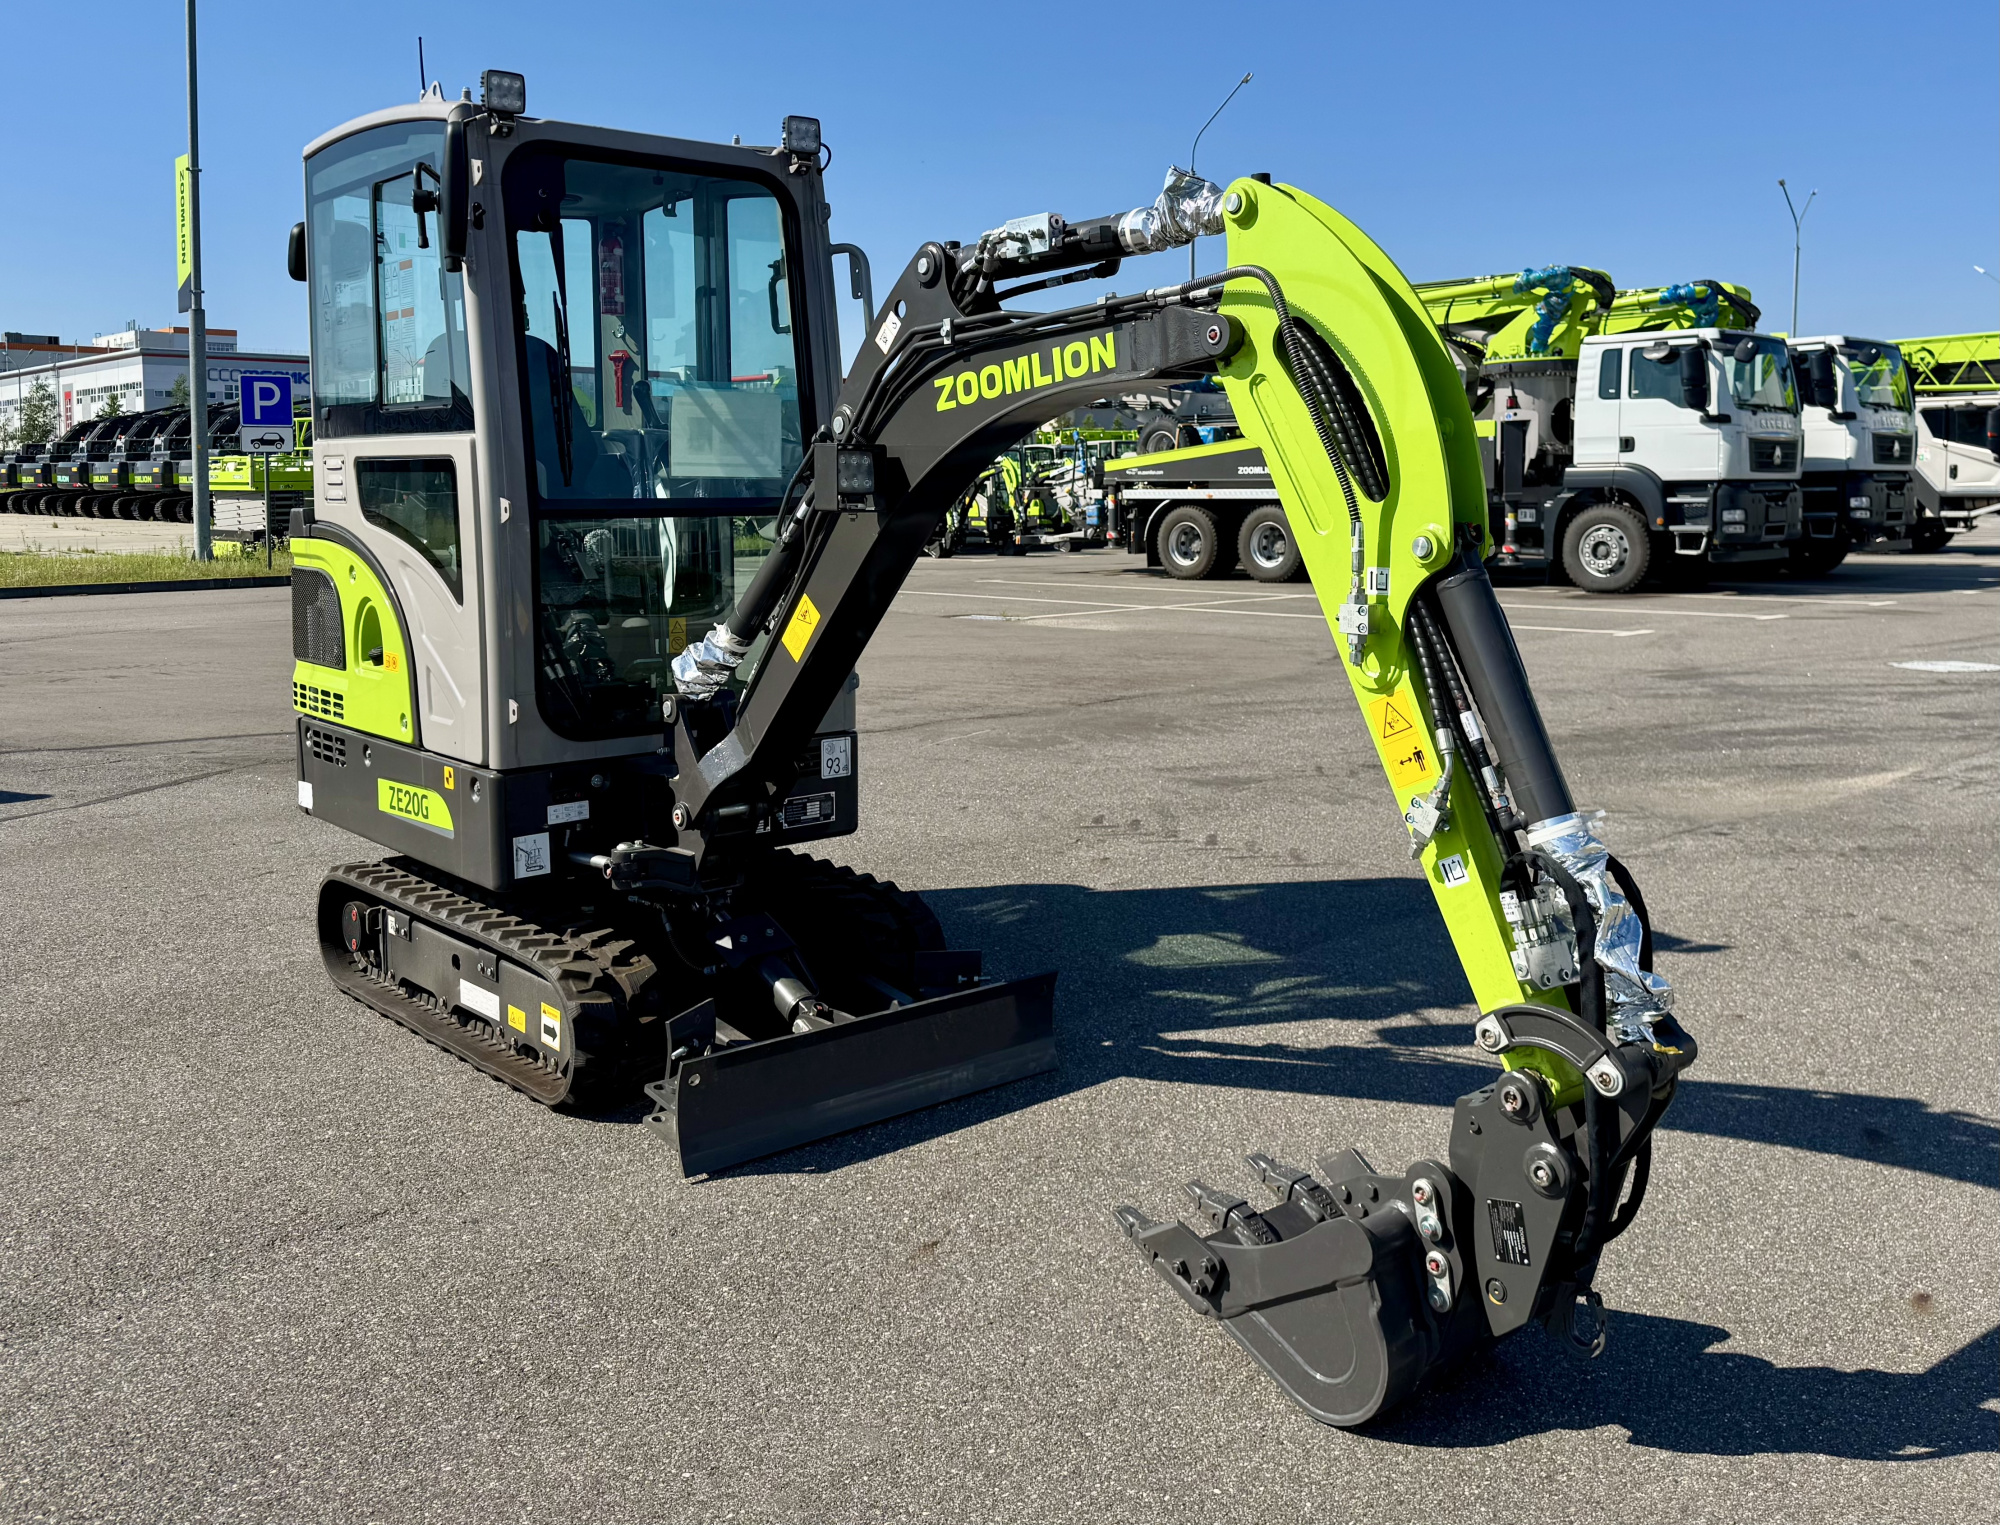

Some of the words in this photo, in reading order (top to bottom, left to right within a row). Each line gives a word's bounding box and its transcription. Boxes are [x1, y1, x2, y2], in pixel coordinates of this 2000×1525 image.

[179, 169, 187, 264] ZOOMLION
[933, 331, 1117, 412] ZOOMLION
[253, 381, 281, 420] P
[826, 757, 841, 775] 93
[388, 785, 429, 820] ZE20G
